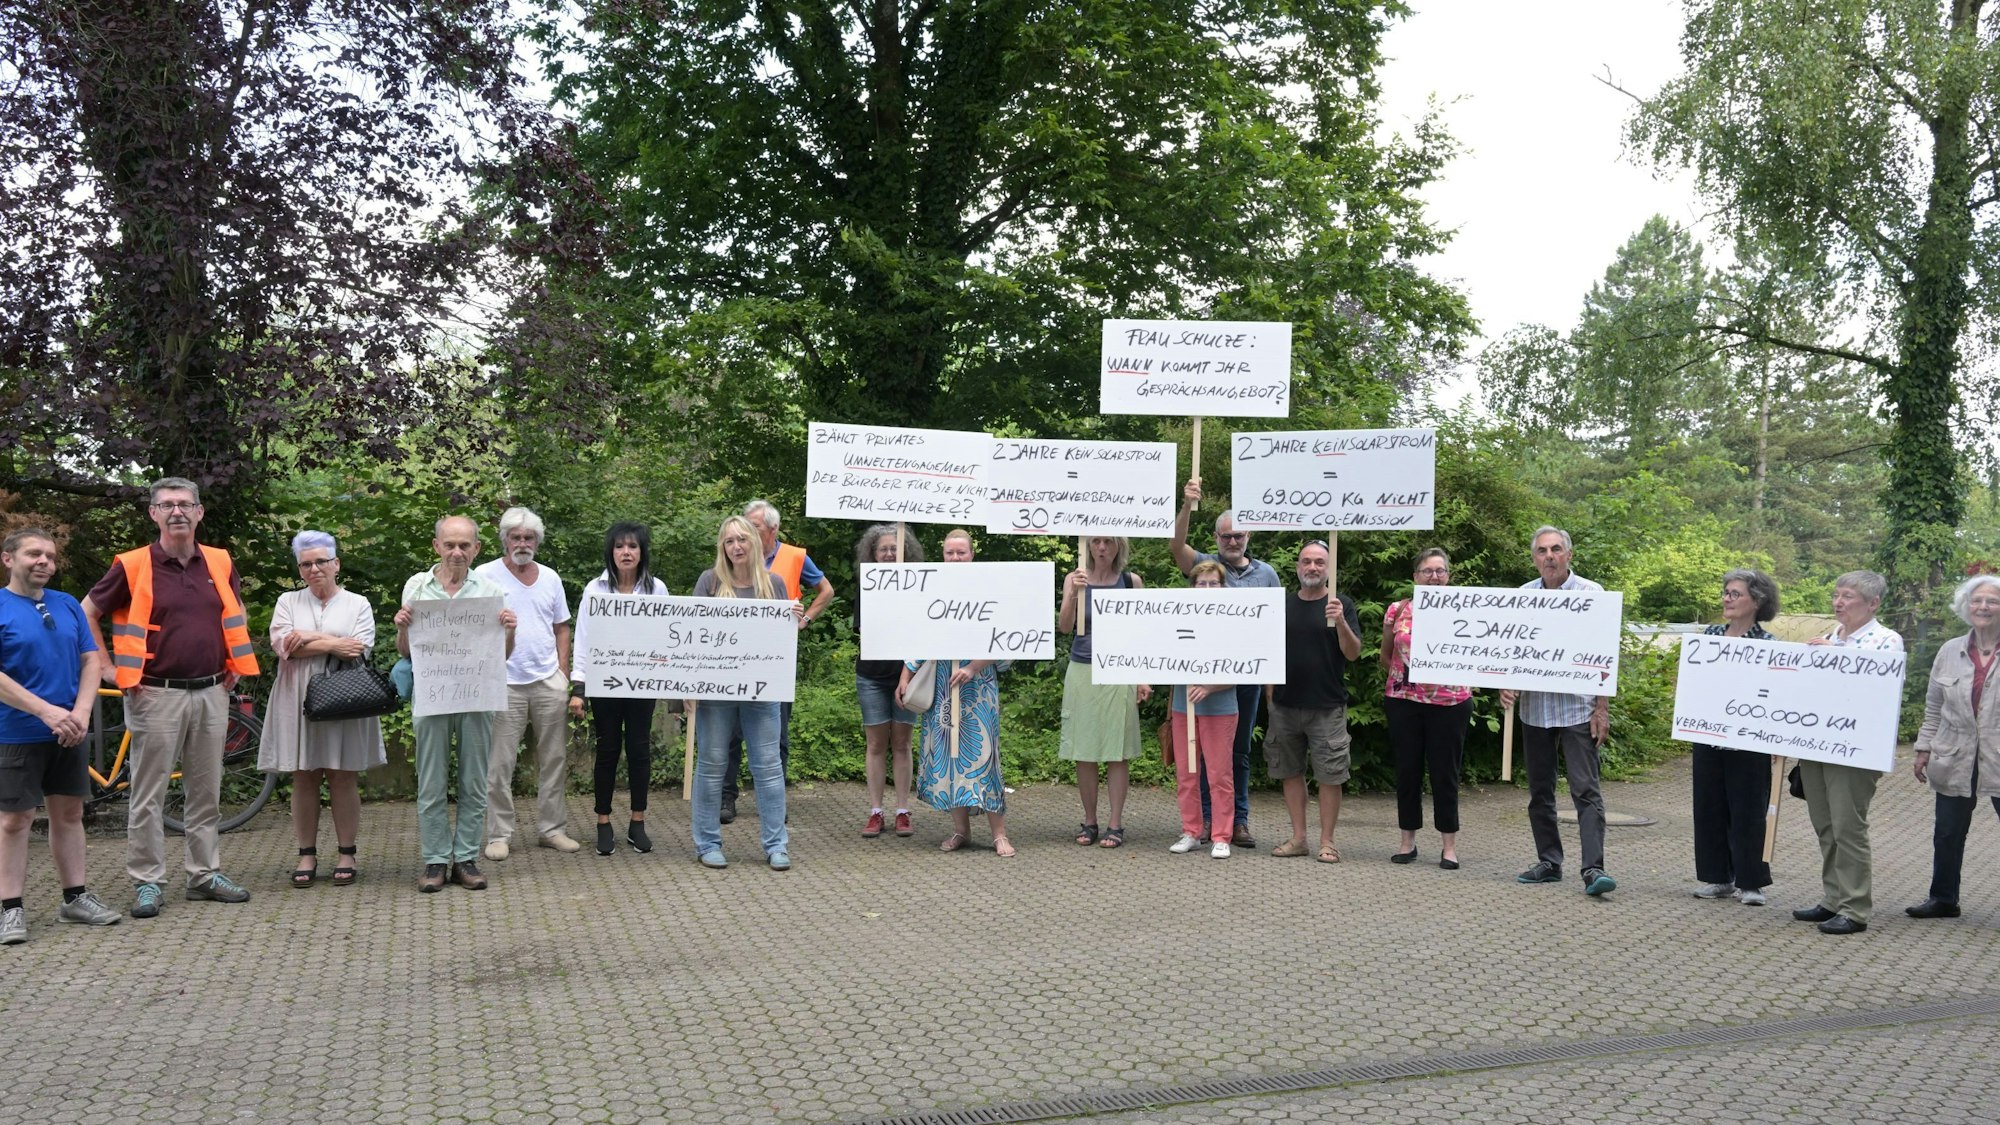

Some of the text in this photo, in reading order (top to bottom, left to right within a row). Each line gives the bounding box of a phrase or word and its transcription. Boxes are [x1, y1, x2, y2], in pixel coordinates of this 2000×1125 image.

[1125, 328, 1170, 348] FRAU
[1107, 356, 1153, 371] WANN
[1160, 359, 1211, 375] KOMMT
[1136, 379, 1287, 405] GESPRÄCHSANGEBOT?
[815, 428, 925, 446] ZÄHLT PRIVATES
[1238, 436, 1256, 461] 2
[1259, 438, 1307, 457] JAHRE
[1350, 434, 1432, 451] SOLARSTROM
[993, 443, 1006, 460] 2
[1009, 444, 1059, 461] JAHRE
[1093, 449, 1161, 461] SOLARSTROM
[843, 452, 981, 476] UMWELTENGAGEMENT
[812, 470, 838, 484] DER
[841, 473, 902, 489] BÜRGER
[907, 478, 931, 490] FÜR
[838, 495, 873, 512] FRAU
[990, 487, 1171, 506] JAHRESSTROMVERBRAUCH VON
[1262, 488, 1332, 507] 69.000
[1342, 492, 1364, 507] KG
[1012, 507, 1049, 529] 30
[1238, 510, 1307, 523] ERSPARTE
[863, 568, 937, 592] STADT
[589, 596, 791, 621] DACHFLÄCHENNUTZUNGSVERTRAG
[927, 598, 998, 622] OHNE
[1094, 598, 1269, 619] VERTRAUENSVERLUST
[1418, 591, 1594, 614] BÜRGERSOLARANLAGE
[420, 609, 485, 630] Mietvertrag
[1453, 619, 1543, 640] 2 JAHRE
[988, 627, 1052, 653] KOPF
[1096, 653, 1268, 675] VERWALTUNGSFRUST
[1411, 659, 1454, 669] REAKTION
[1456, 662, 1473, 671] DER
[1427, 643, 1614, 669] VERTRAGSBRUCH OHNE
[1687, 639, 1701, 664] 2
[1707, 641, 1765, 664] JAHRE
[1802, 650, 1903, 678] SOLARSTROM
[1676, 716, 1733, 733] VERPASSTE
[1725, 699, 1856, 731] 600.000 KM
